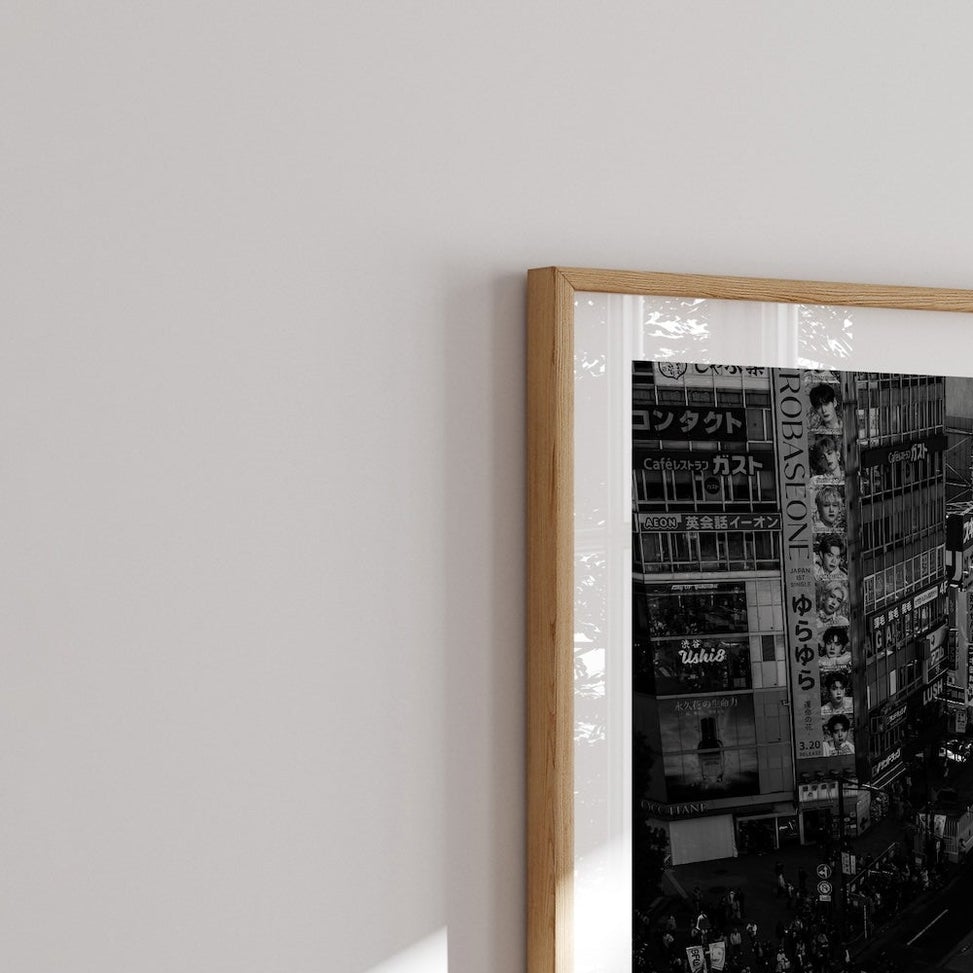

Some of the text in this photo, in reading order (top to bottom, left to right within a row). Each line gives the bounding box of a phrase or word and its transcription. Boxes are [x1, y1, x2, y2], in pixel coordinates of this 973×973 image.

[632, 409, 743, 434] コンタクト
[712, 454, 765, 476] ガスト
[779, 368, 811, 561] ROBASEONE
[645, 517, 678, 528] AEON
[685, 516, 779, 530] 英会話イーオン
[792, 594, 815, 691] ゆらゆら
[678, 648, 727, 664] Ushi8
[923, 678, 943, 706] LUSH
[799, 740, 821, 751] 3.20
